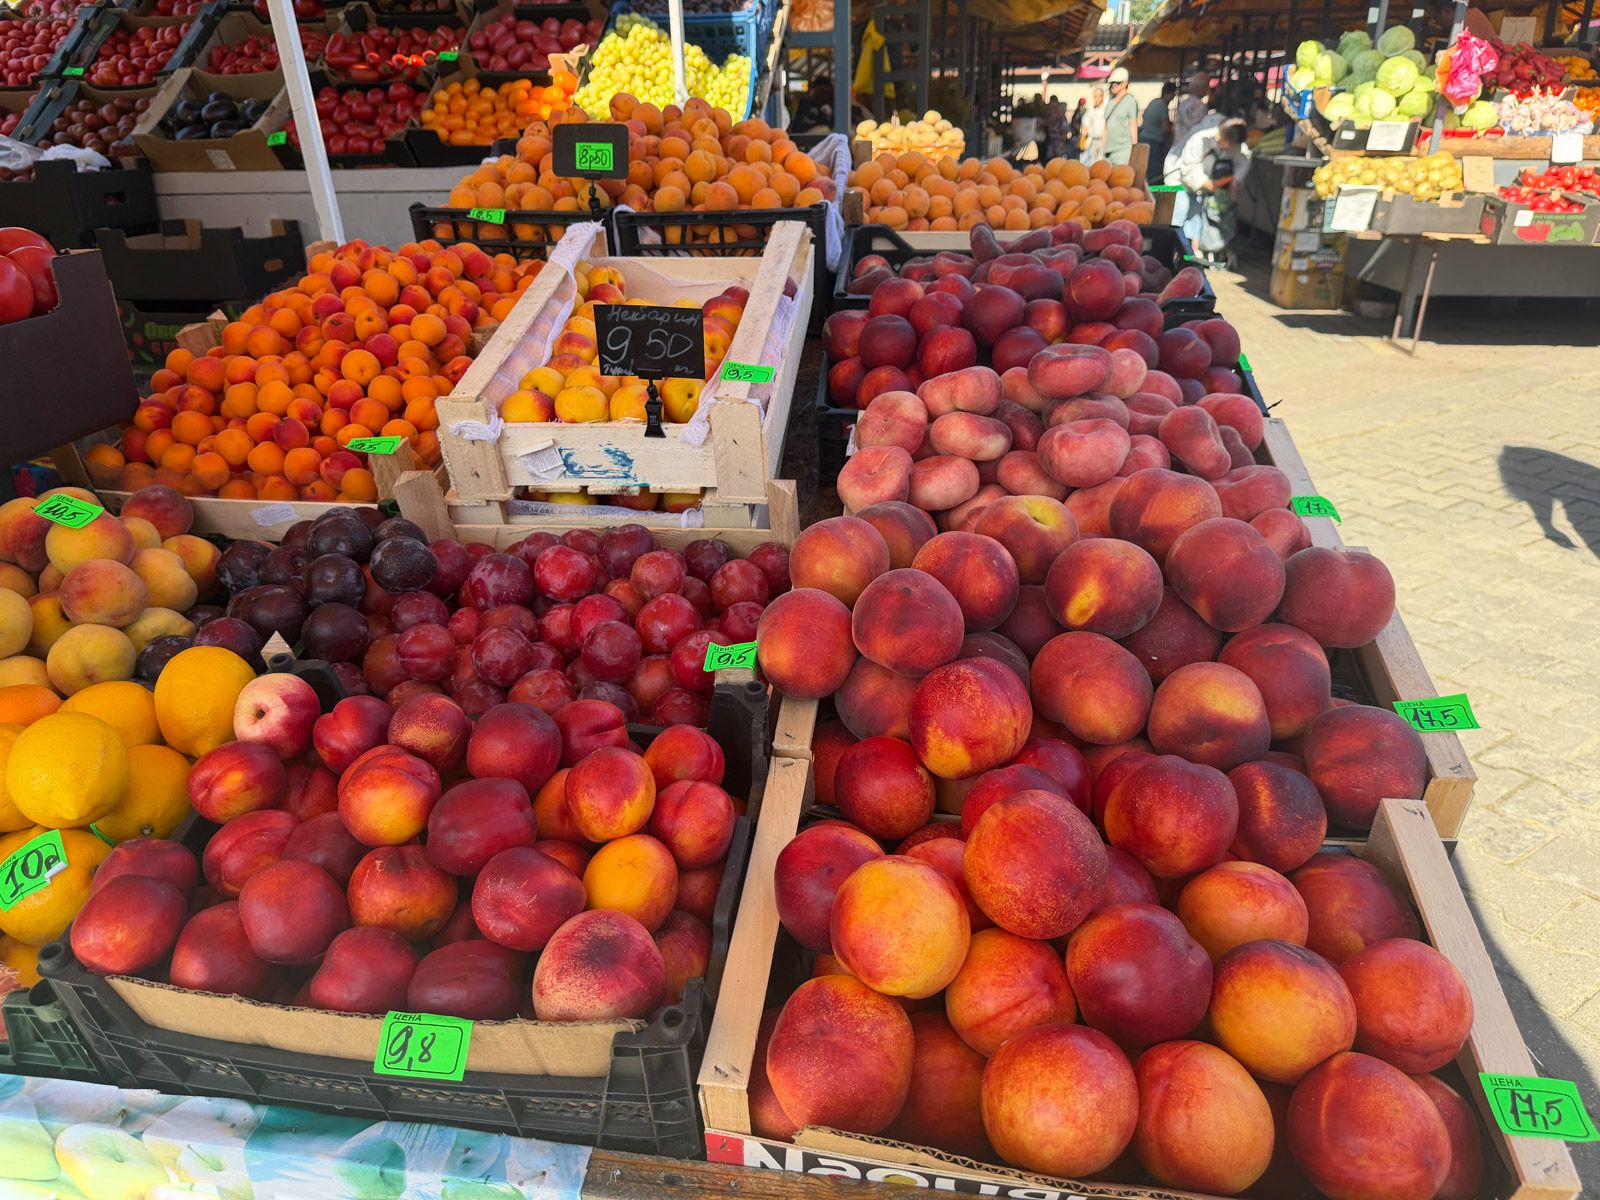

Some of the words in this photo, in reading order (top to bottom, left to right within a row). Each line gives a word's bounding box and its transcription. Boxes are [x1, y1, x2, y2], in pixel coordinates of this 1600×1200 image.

[606, 304, 701, 327] Нектарин
[1411, 707, 1458, 729] 17,5
[393, 1013, 422, 1021] ЦЕНА
[387, 1025, 437, 1072] 9,8
[1489, 1077, 1524, 1088] ЦЕНА
[1509, 1088, 1564, 1131] 17,5
